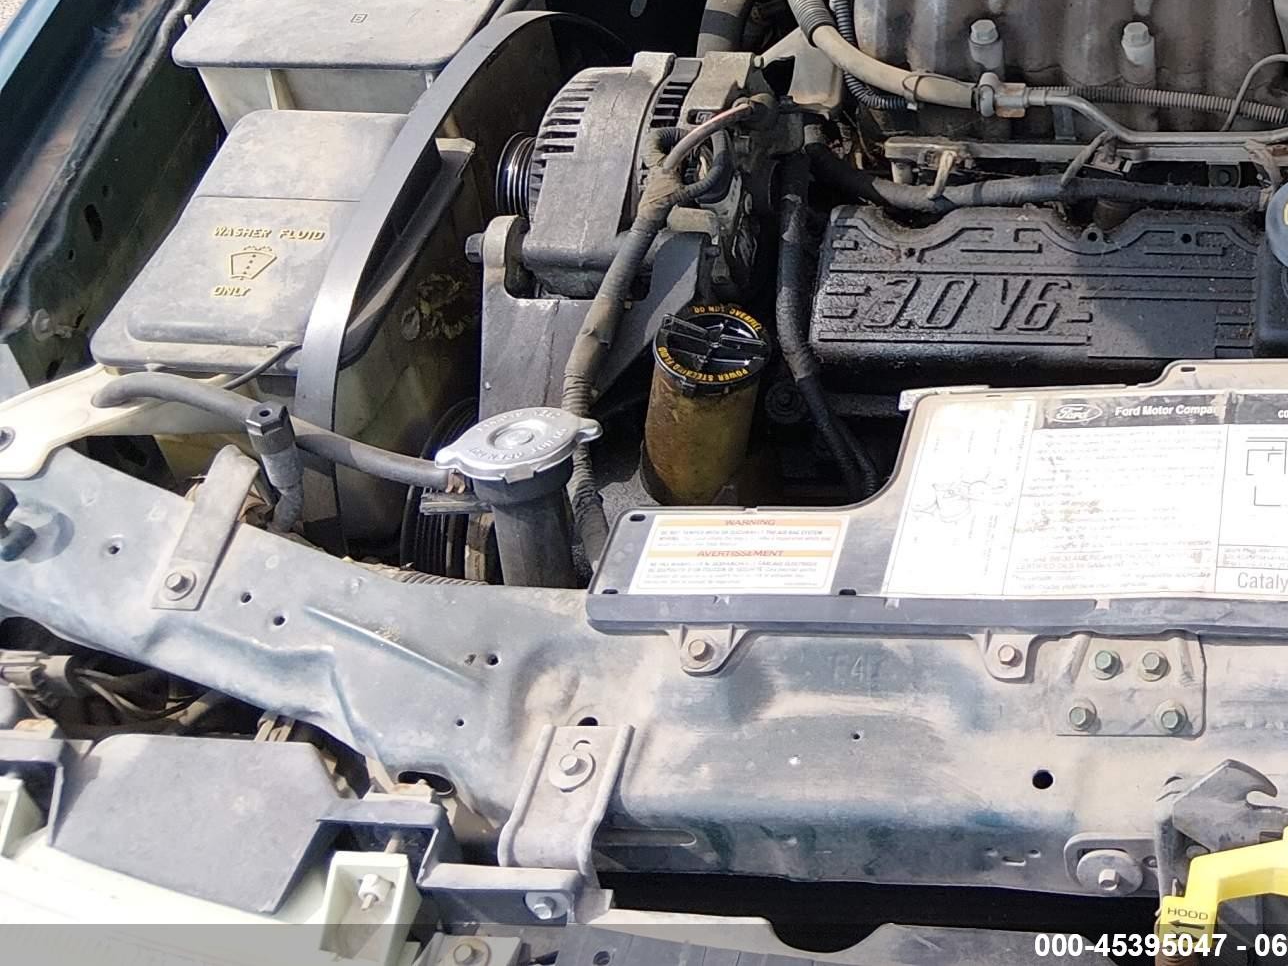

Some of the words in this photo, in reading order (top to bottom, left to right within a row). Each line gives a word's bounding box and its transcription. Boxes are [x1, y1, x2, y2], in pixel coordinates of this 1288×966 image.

[213, 226, 271, 239] WASHER
[280, 229, 325, 241] FLUID
[213, 285, 251, 297] ONLY
[862, 277, 977, 331] 3.0
[991, 278, 1072, 332] V6
[719, 368, 749, 381] POWER
[1115, 405, 1141, 417] Ford
[1143, 405, 1173, 416] Motor
[1176, 404, 1226, 416] Compa
[1167, 907, 1208, 920] HOOD
